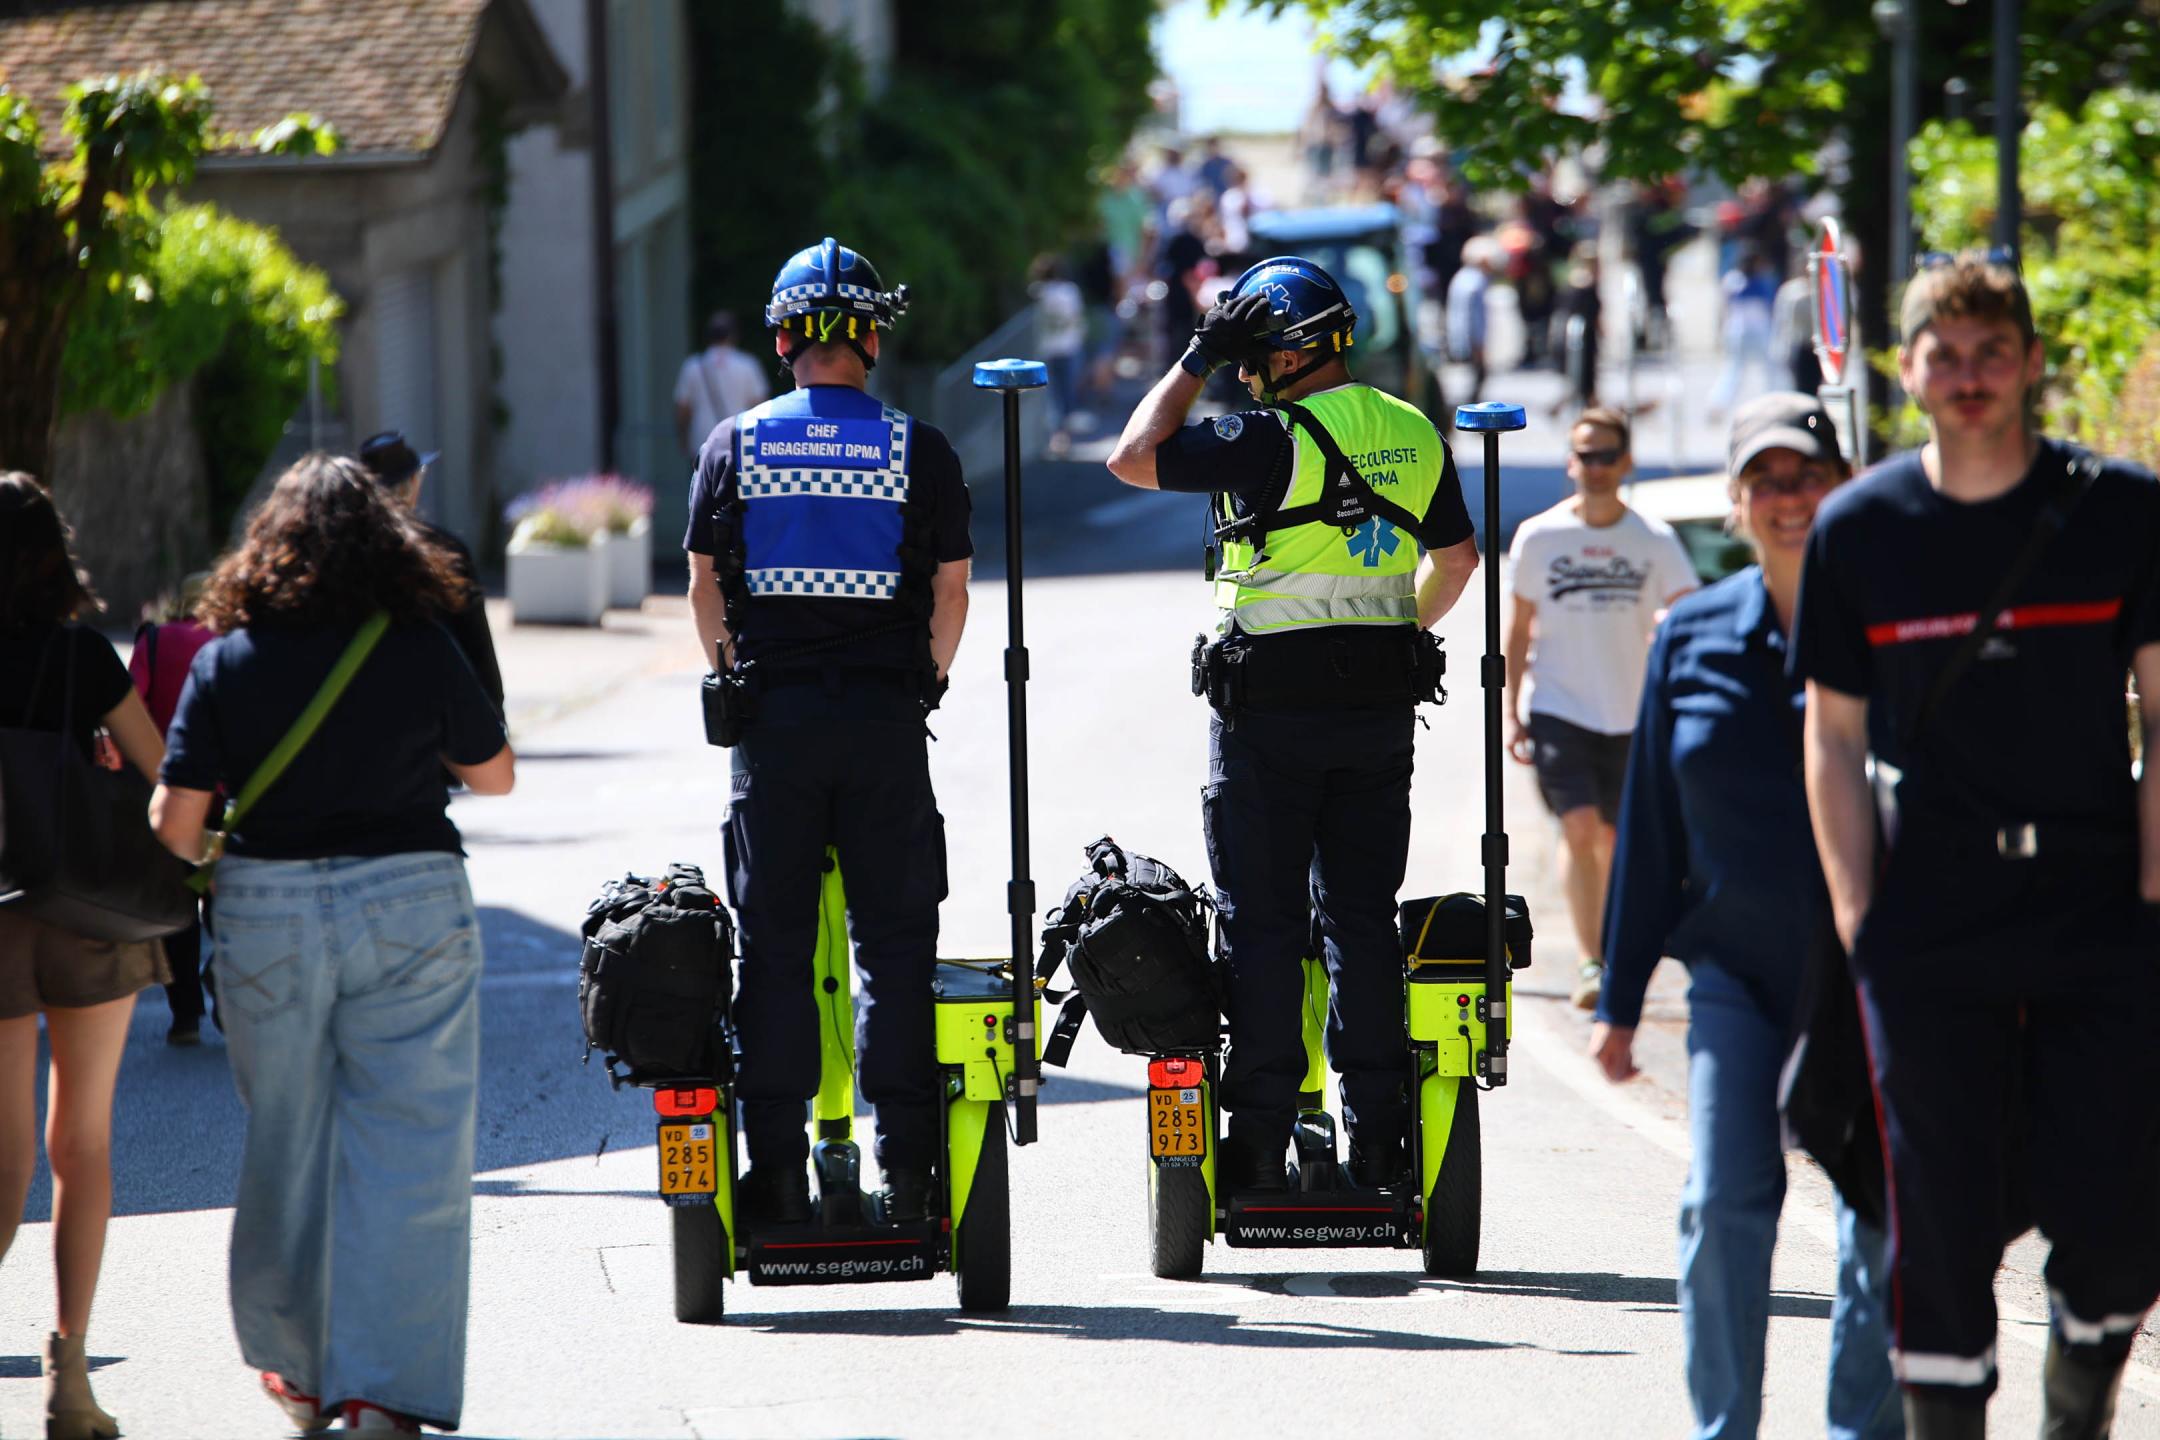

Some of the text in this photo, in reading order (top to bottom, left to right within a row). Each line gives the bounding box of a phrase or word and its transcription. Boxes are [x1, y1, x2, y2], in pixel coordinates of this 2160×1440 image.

[806, 424, 839, 438] CHEF
[760, 442, 881, 459] ENGAGEMENT DPMA
[1349, 448, 1418, 469] ECOURISTE
[1342, 497, 1359, 507] DPMA
[1336, 507, 1365, 518] Secouriste
[1155, 1095, 1172, 1105] VD
[1158, 1110, 1196, 1128] 285
[665, 1130, 682, 1141] VD
[693, 1128, 705, 1136] 25
[1159, 1133, 1198, 1151] 973
[667, 1146, 708, 1165] 285
[667, 1170, 708, 1189] 974
[1239, 1222, 1396, 1241] www.segway.ch
[760, 1255, 924, 1276] www.segway.ch
